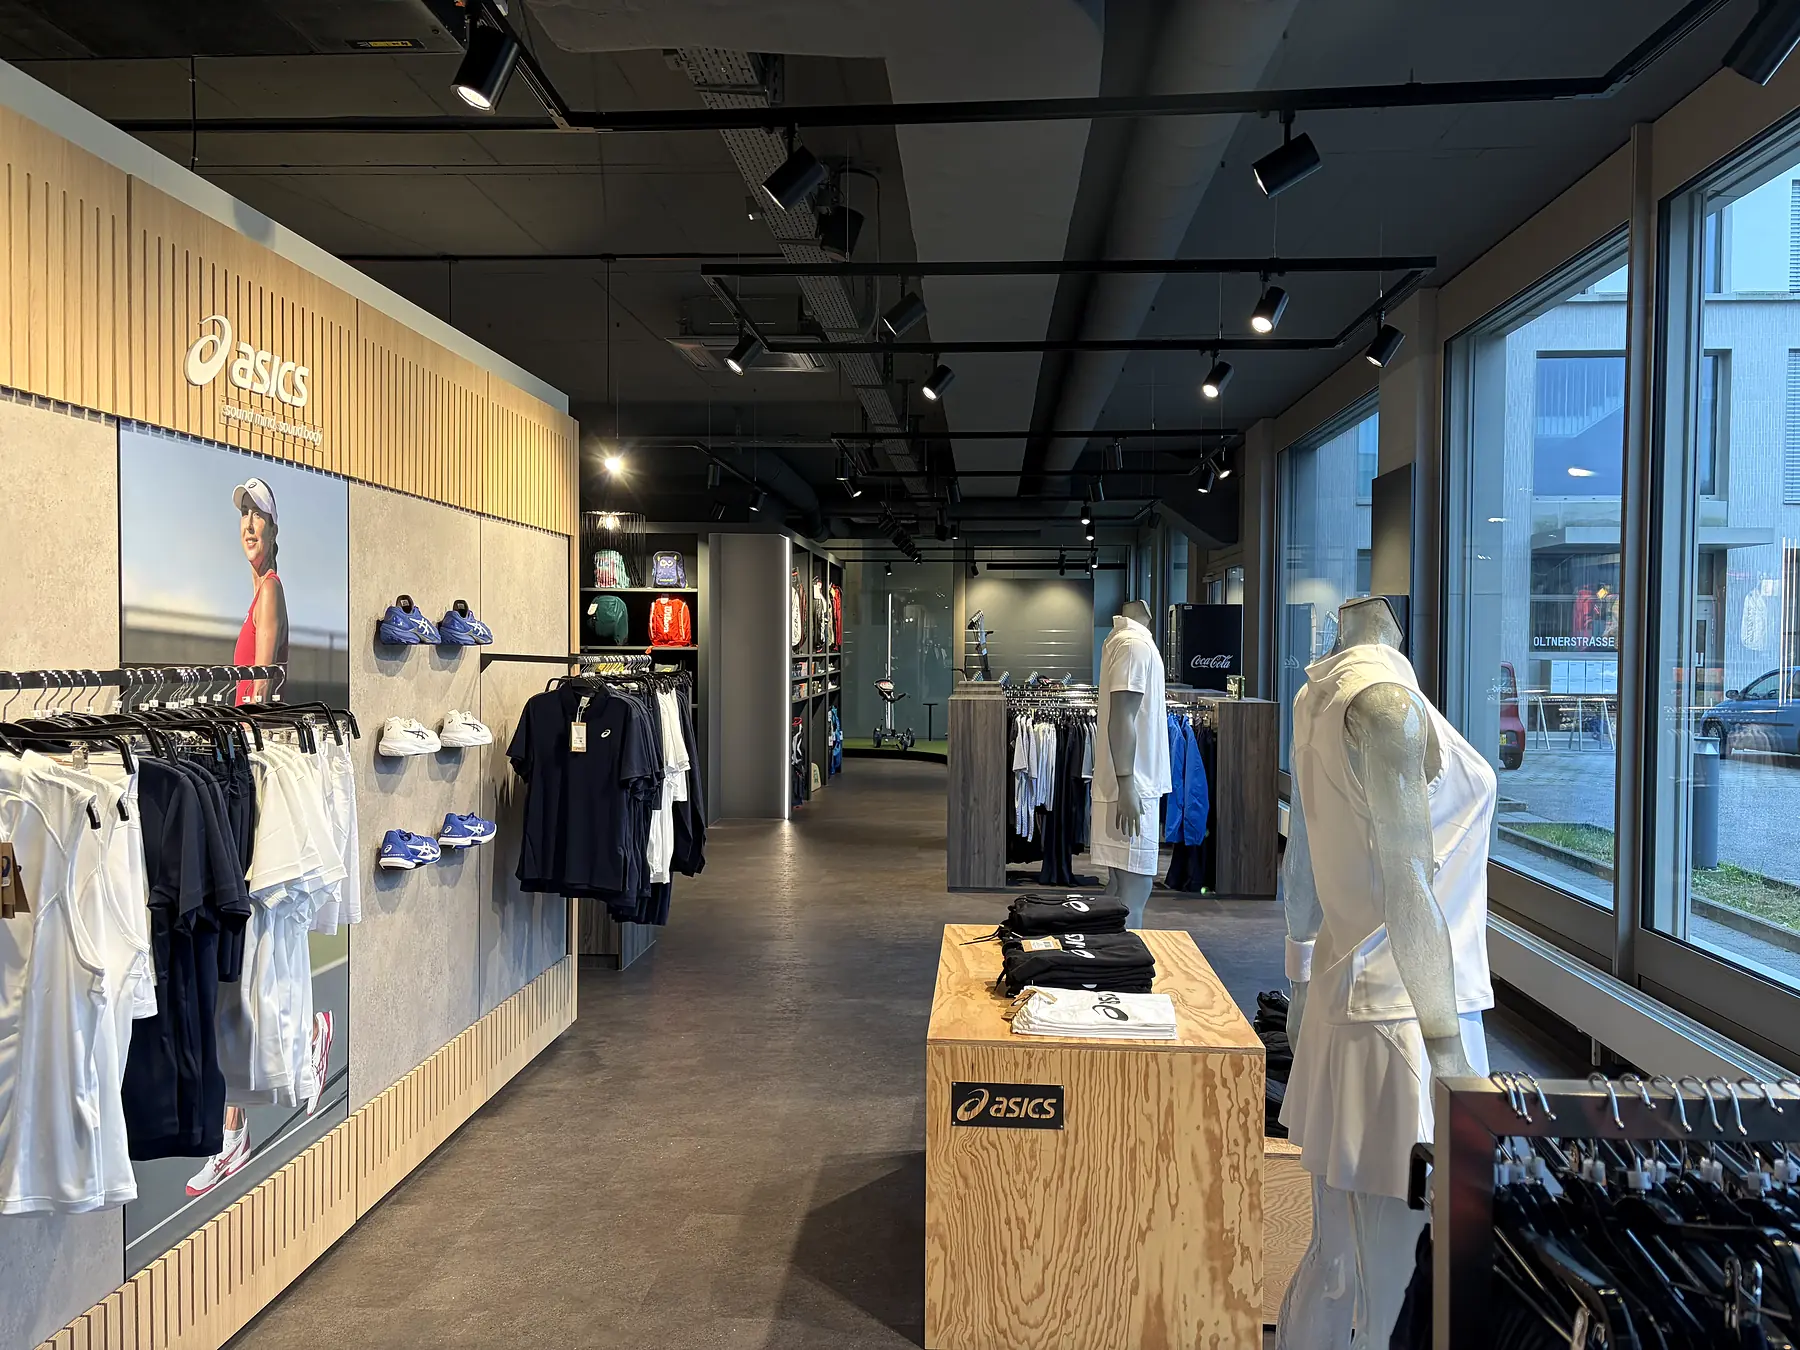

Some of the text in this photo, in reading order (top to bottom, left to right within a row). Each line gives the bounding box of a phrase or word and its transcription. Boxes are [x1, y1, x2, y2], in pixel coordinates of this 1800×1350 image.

[224, 405, 254, 422] sound
[278, 421, 304, 437] sound
[303, 423, 323, 446] body
[1533, 636, 1615, 647] OLTNERSTRASSE
[1190, 654, 1234, 669] Coca-Cola
